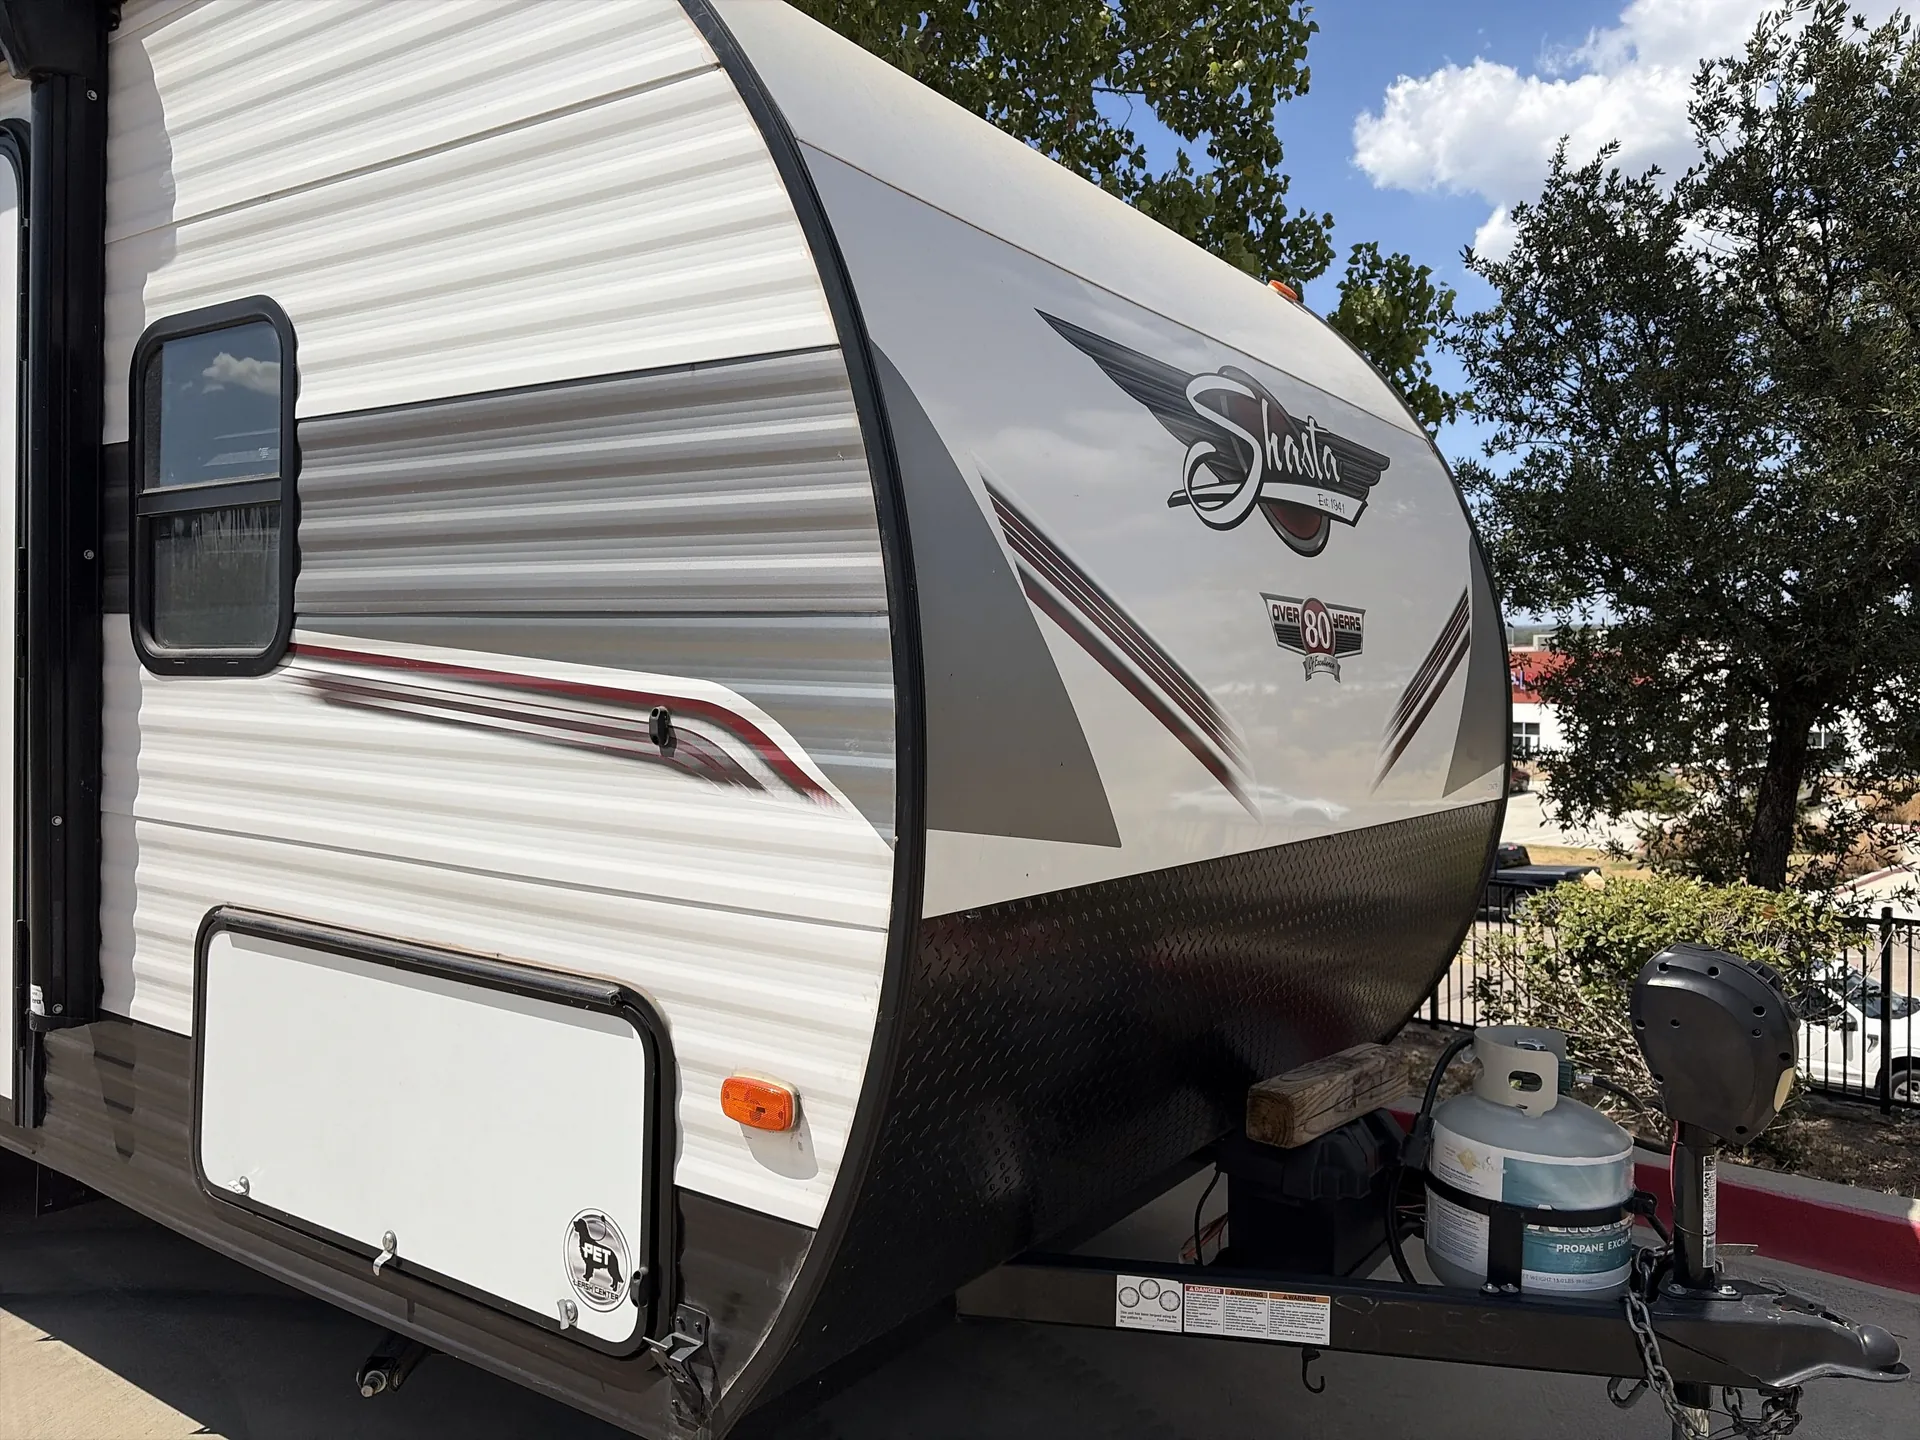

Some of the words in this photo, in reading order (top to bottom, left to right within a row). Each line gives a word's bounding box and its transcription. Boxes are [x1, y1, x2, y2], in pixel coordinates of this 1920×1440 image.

[1183, 373, 1341, 529] Shasta
[1272, 604, 1300, 624] OVER
[1304, 609, 1331, 649] 80
[1332, 613, 1361, 631] YEARS
[581, 1242, 611, 1265] PET
[1556, 1243, 1604, 1253] PROPANE
[573, 1279, 593, 1292] LEASH
[594, 1286, 619, 1301] CENTER
